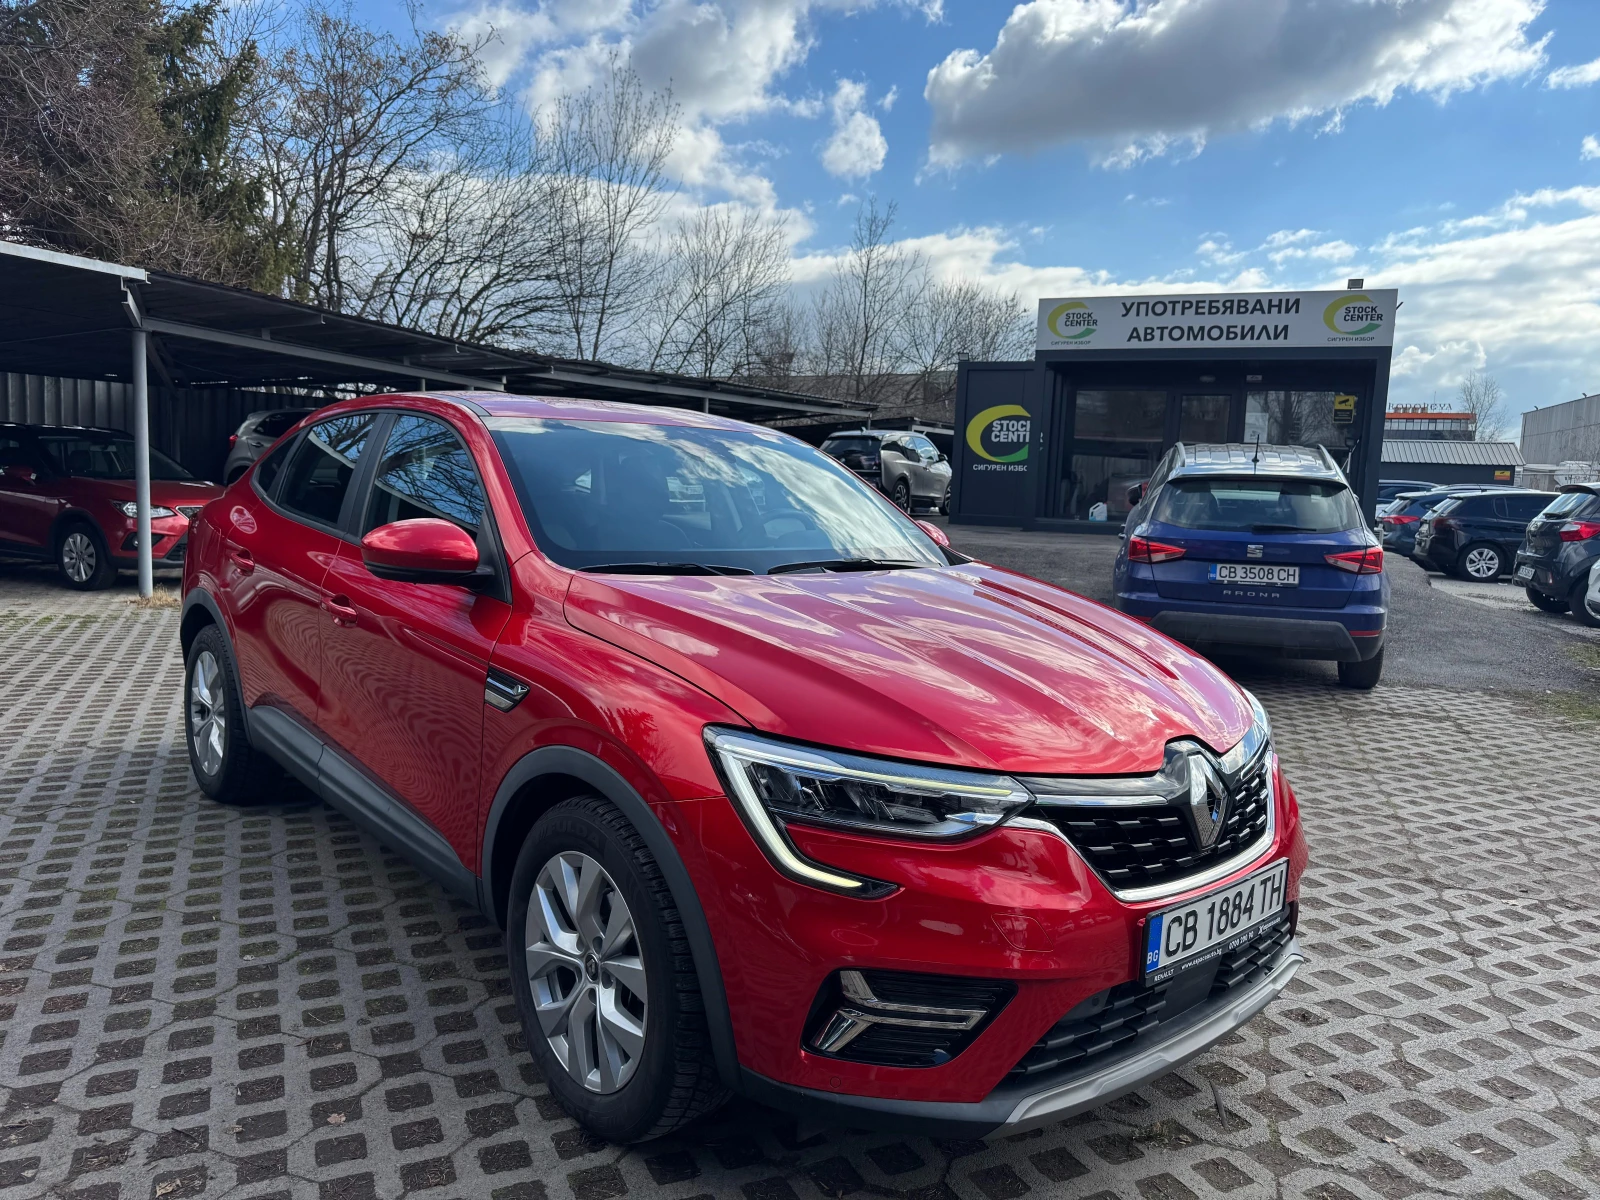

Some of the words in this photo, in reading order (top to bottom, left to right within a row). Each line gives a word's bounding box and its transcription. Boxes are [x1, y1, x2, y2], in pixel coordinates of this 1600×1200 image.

[1121, 298, 1300, 317] УПОТРЕБЯВАНИ
[1344, 306, 1378, 314] STOCK
[1064, 319, 1098, 327] CENTER
[1065, 312, 1093, 320] STOCK
[1343, 313, 1383, 322] CENTER
[1126, 324, 1289, 342] АВТОМОБИЛИ
[1219, 565, 1237, 579] CB
[1239, 566, 1275, 581] 3508
[1277, 568, 1296, 582] CH
[1223, 590, 1280, 598] ARONA
[1164, 909, 1198, 957] CB
[1207, 883, 1256, 941] 1884
[1260, 869, 1284, 915] TH
[1147, 949, 1159, 965] BG
[1154, 968, 1175, 982] RENAULT
